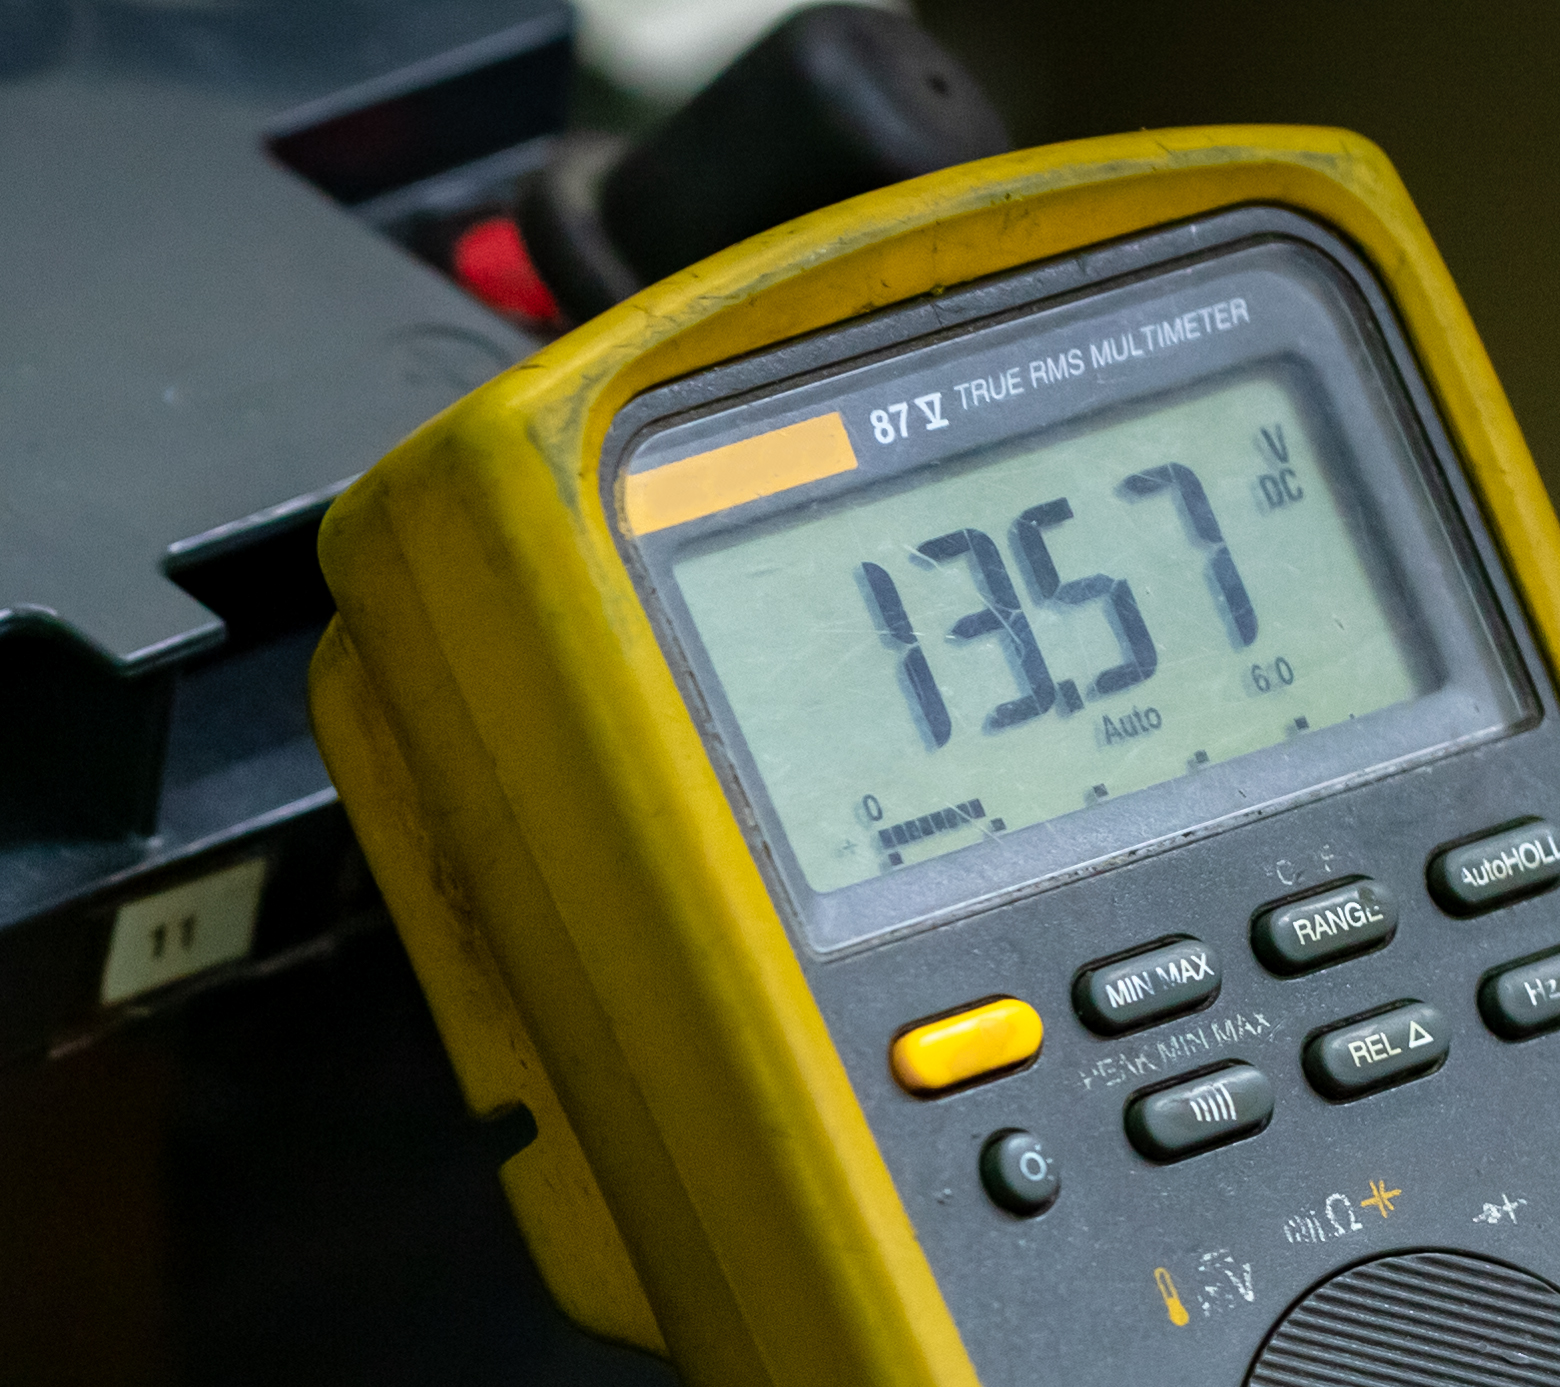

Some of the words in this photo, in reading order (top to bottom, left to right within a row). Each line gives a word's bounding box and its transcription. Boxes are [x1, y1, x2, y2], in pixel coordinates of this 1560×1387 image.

[954, 367, 1025, 410] TRUE
[1029, 349, 1086, 388] RMS
[1090, 298, 1251, 369] MULTIMETER
[1260, 424, 1289, 463] V
[1258, 467, 1304, 509] DC
[1101, 704, 1162, 745] Auto
[1105, 971, 1155, 1009] MIN
[1155, 952, 1215, 991] MAX
[1348, 1030, 1402, 1067] REL
